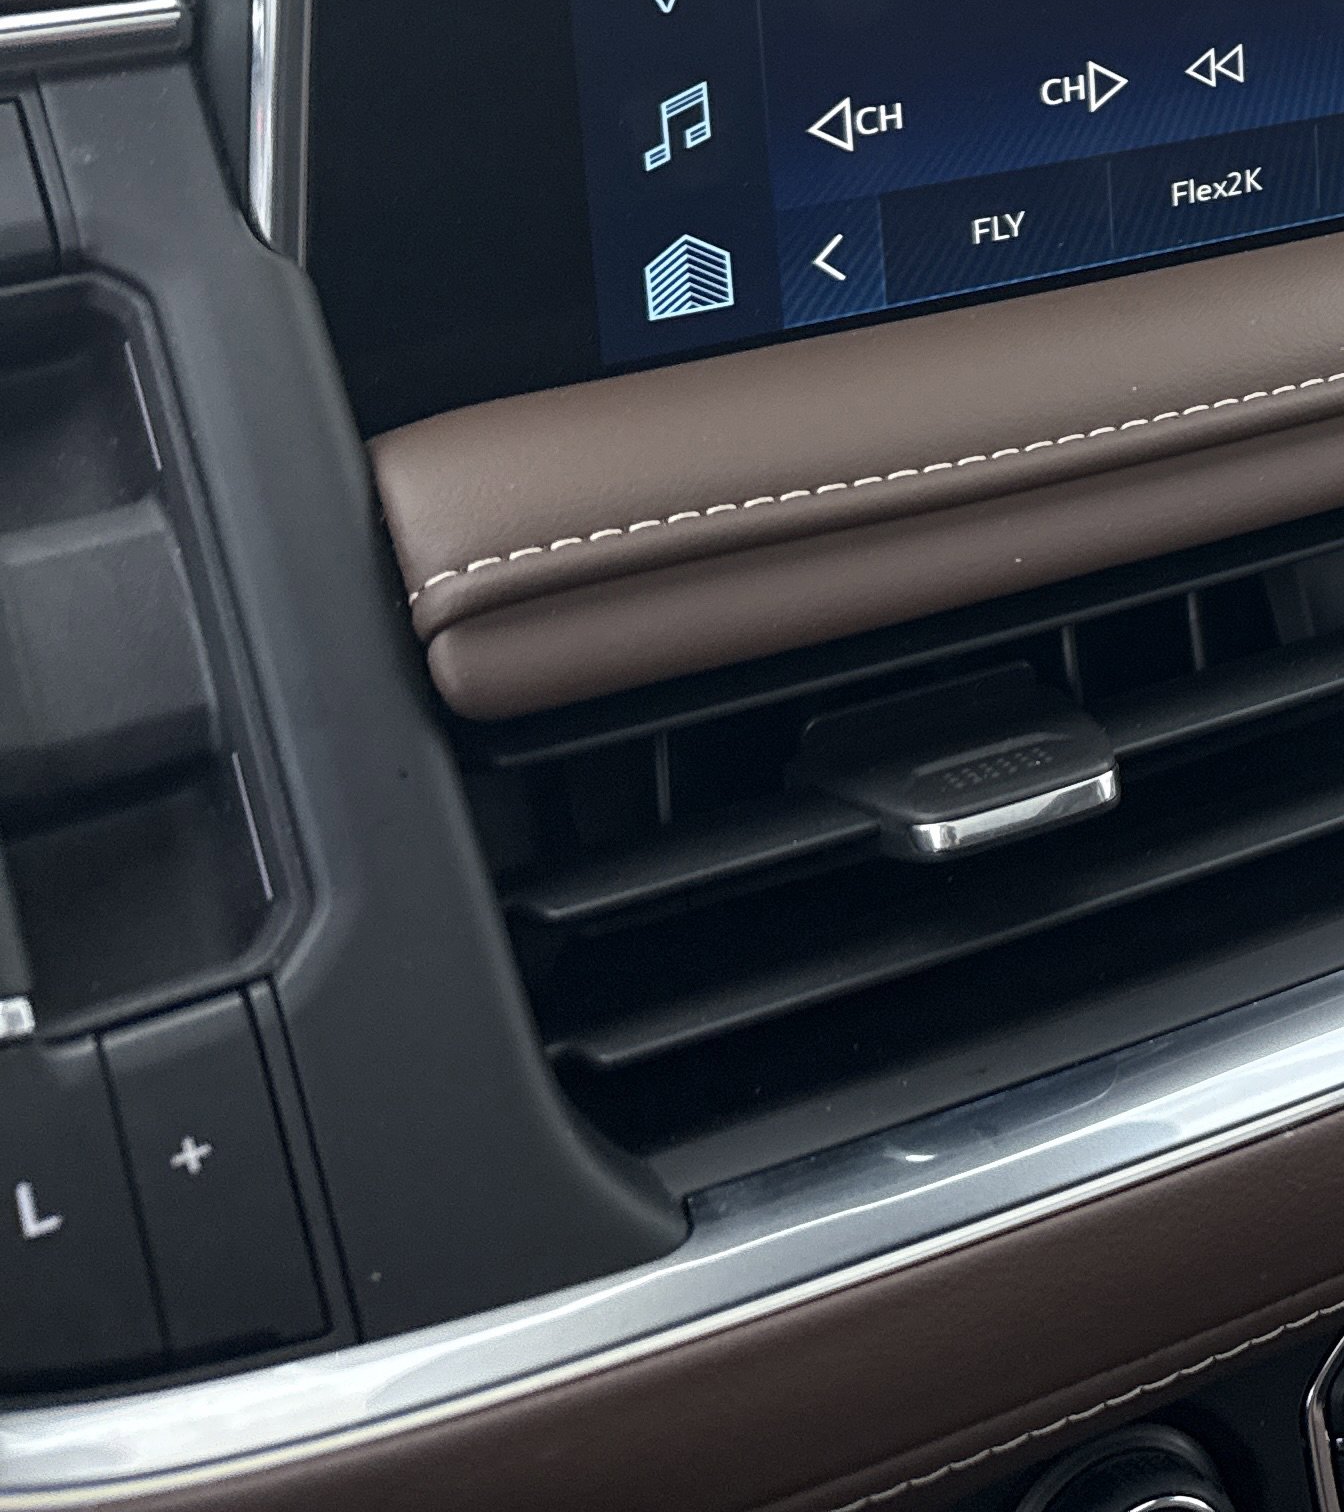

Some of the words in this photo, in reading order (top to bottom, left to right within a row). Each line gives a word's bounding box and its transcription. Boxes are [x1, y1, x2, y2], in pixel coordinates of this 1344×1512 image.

[1041, 74, 1086, 106] CH
[855, 102, 904, 136] CH
[1171, 165, 1264, 207] Flex2K
[972, 210, 1027, 245] FLY
[15, 1182, 64, 1239] L
